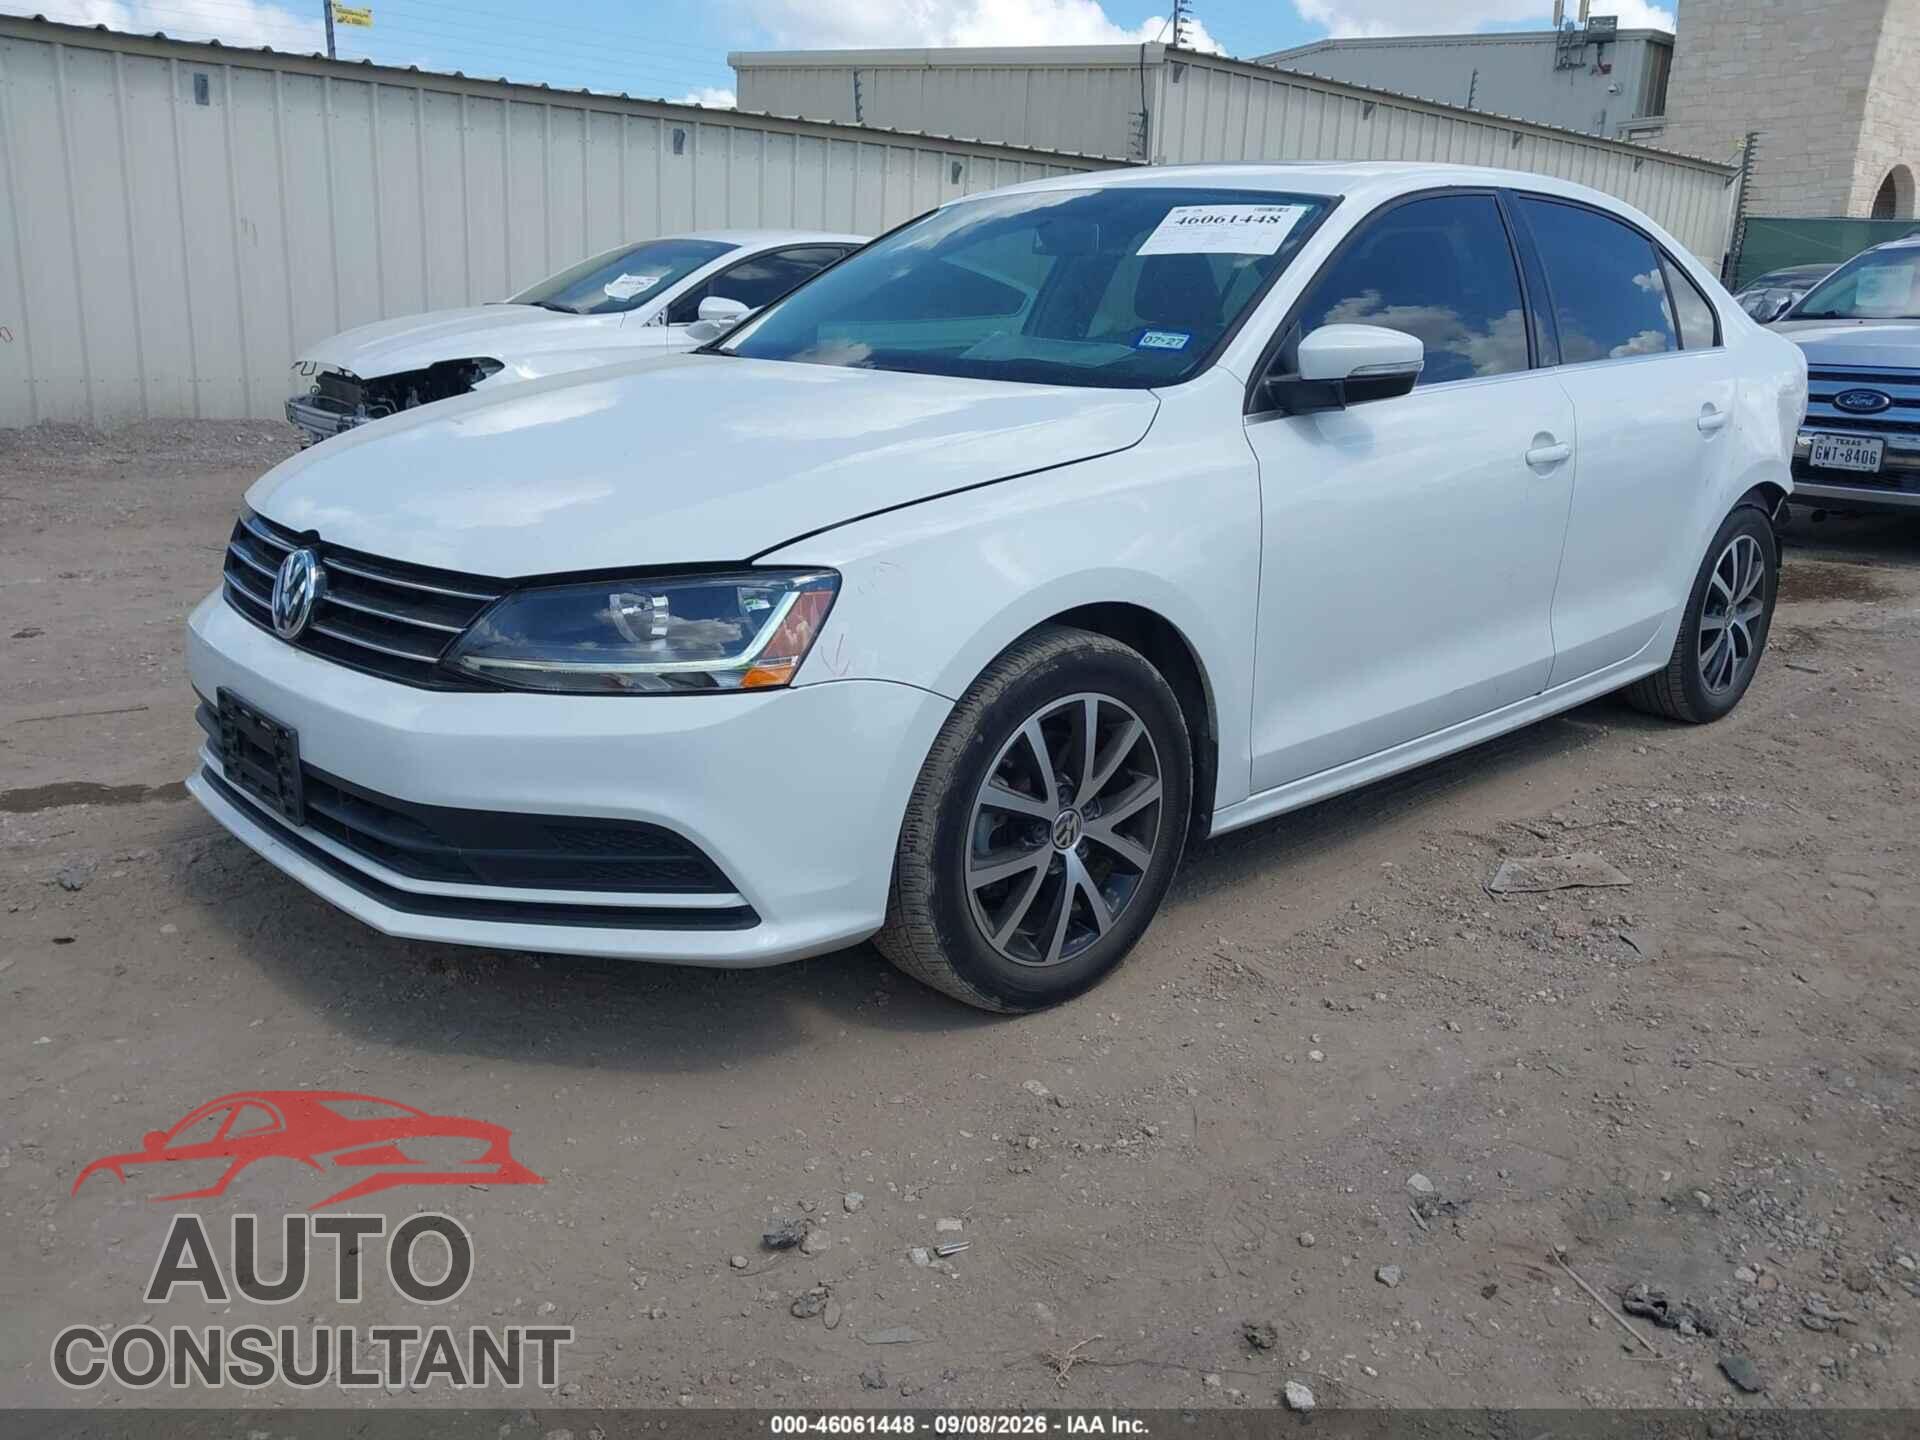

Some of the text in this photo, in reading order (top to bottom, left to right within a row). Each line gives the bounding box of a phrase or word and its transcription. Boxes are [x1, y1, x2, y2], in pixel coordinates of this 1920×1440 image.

[1176, 214, 1281, 225] 46061448
[1845, 394, 1878, 407] Ford
[1836, 438, 1862, 447] TEXAS
